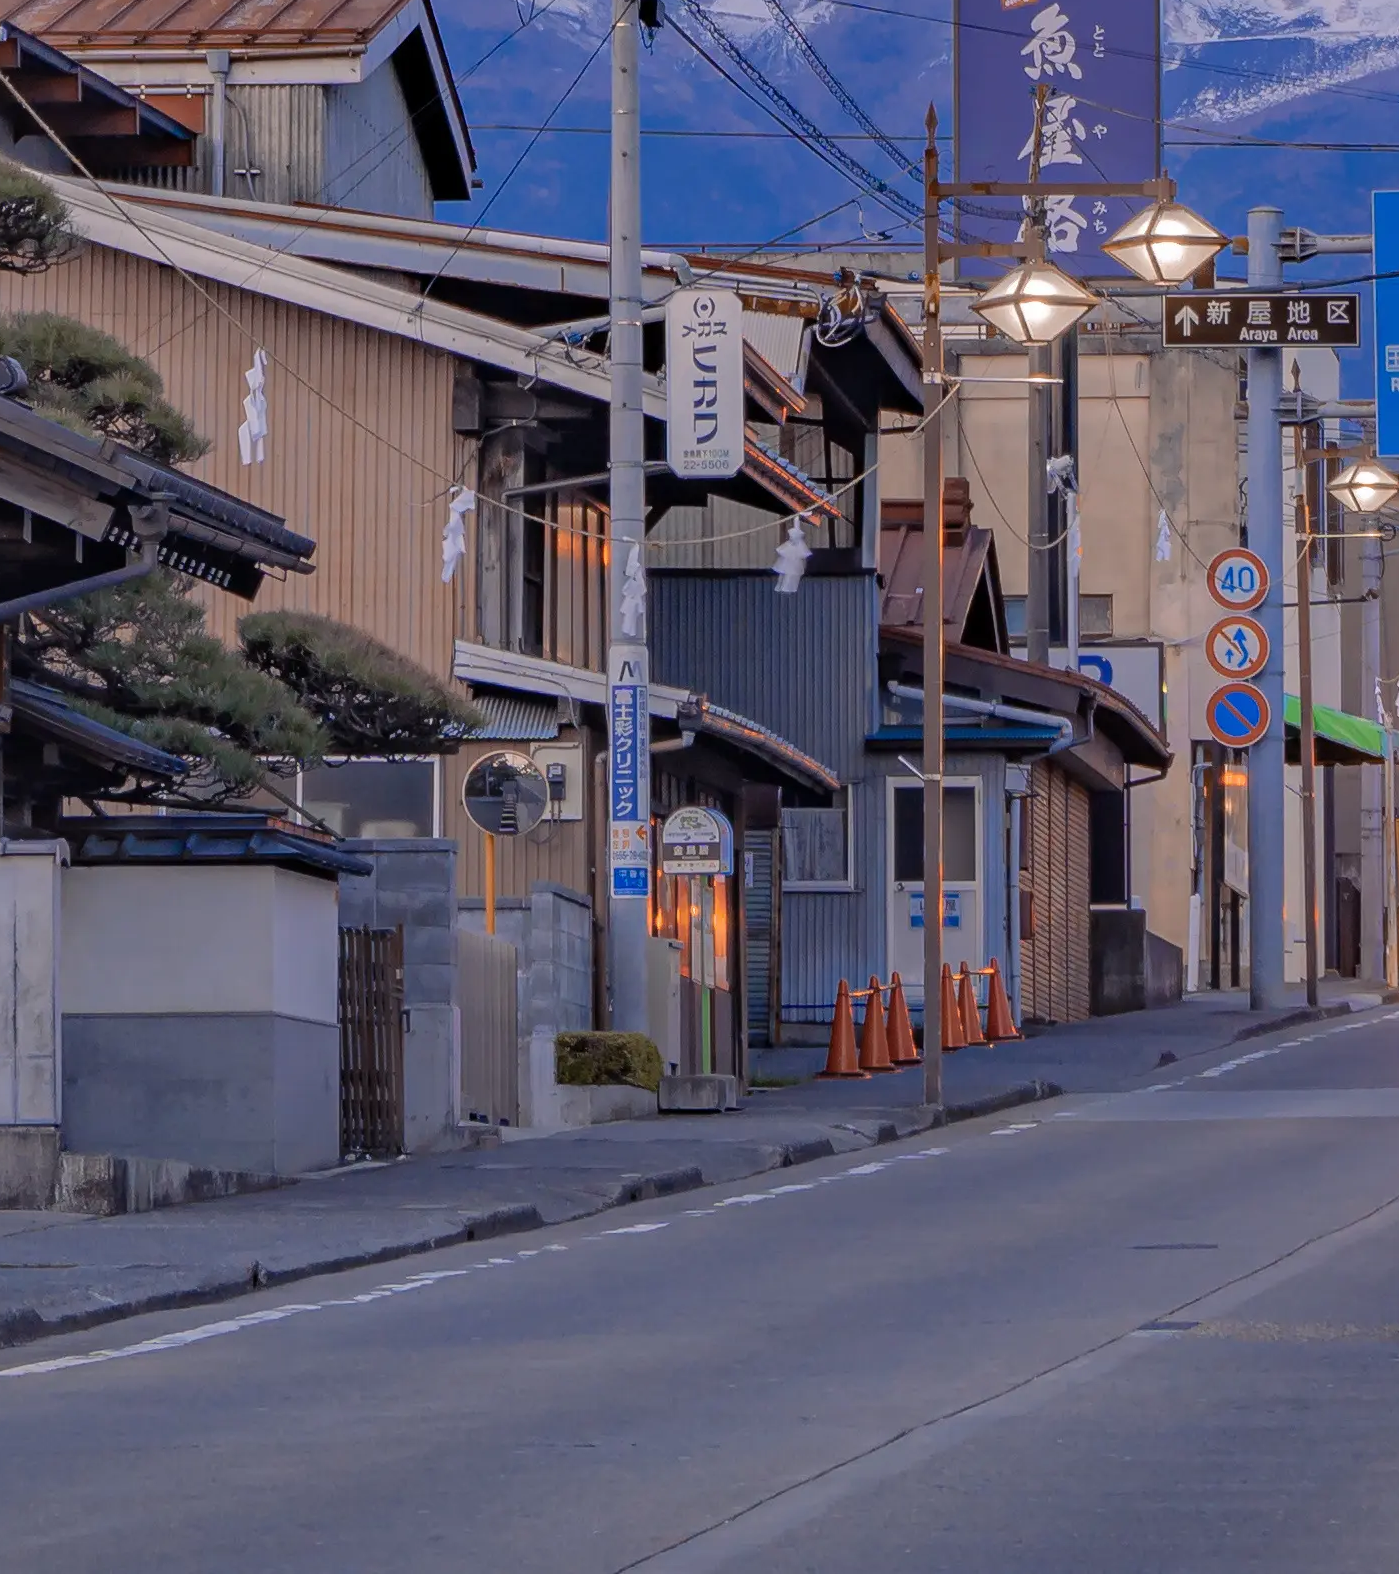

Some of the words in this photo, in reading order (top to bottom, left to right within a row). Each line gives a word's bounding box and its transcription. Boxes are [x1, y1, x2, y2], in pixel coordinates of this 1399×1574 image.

[1206, 299, 1350, 325] 新屋地区
[1239, 327, 1277, 341] Araya
[1287, 327, 1319, 341] Area
[1221, 566, 1254, 593] 40
[614, 689, 634, 817] 富士彩クリニック
